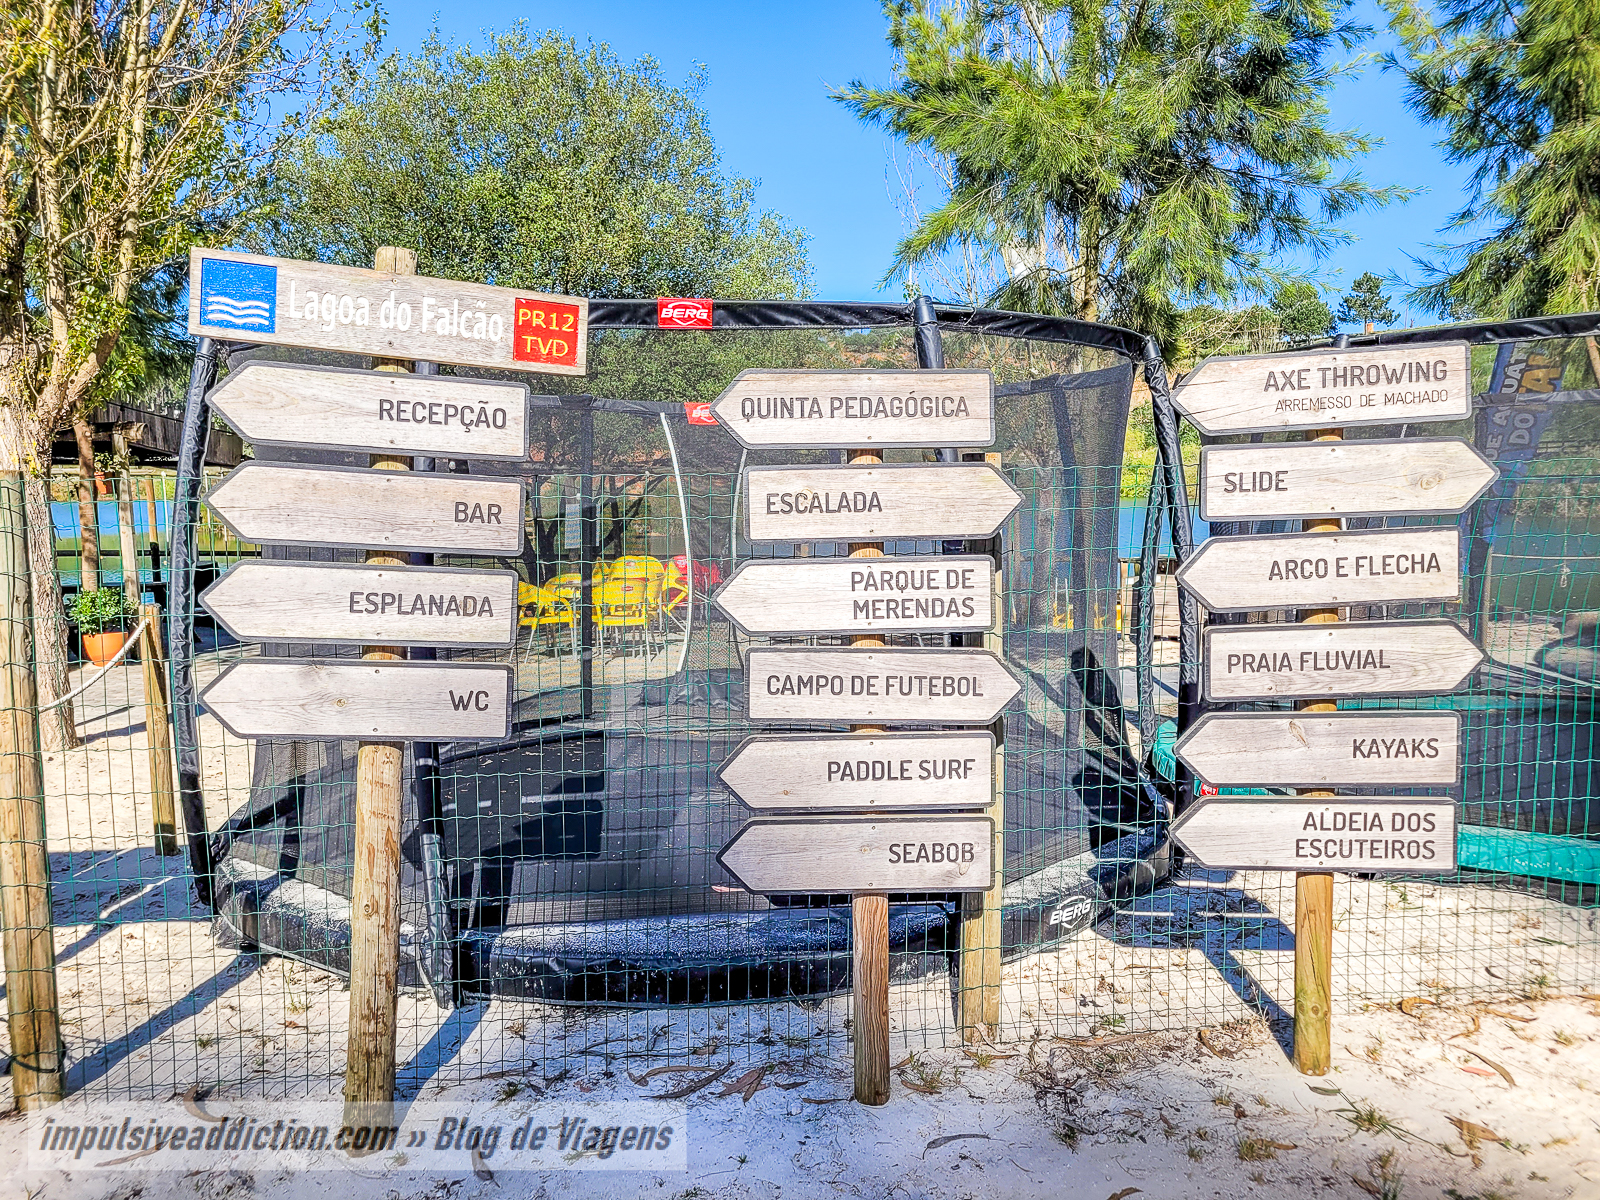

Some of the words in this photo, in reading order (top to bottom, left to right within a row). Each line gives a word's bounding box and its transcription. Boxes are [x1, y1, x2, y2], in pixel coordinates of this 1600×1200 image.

[289, 280, 371, 332] Lagoa
[380, 292, 412, 332] do
[422, 298, 504, 342] Falcão
[518, 308, 575, 332] PR12
[661, 308, 708, 319] BERG
[522, 336, 569, 357] TVD
[1264, 368, 1311, 392] AXE
[1317, 360, 1448, 388] THROWING
[741, 396, 823, 422] QUINTA
[830, 391, 970, 418] PEDAGÓGICA
[1275, 395, 1352, 413] ARREMESSO
[1360, 393, 1377, 407] DE
[1384, 389, 1449, 406] MACHADO
[379, 398, 507, 433] RECEPÇÃO
[1509, 413, 1535, 445] DO
[1224, 471, 1289, 493] SLIDE
[454, 501, 502, 524] BAR
[766, 491, 883, 515] ESCALADA
[1268, 557, 1329, 581] ARCO
[1336, 557, 1349, 578] E
[1355, 552, 1442, 576] FLECHA
[850, 569, 939, 593] PARQUE
[946, 568, 975, 589] DE
[350, 591, 494, 617] ESPLANADA
[853, 597, 975, 620] MERENDAS
[1228, 652, 1293, 673] PRAIA
[1299, 649, 1391, 672] FLUVIAL
[767, 675, 844, 696] CAMPO
[851, 675, 879, 696] DE
[885, 676, 984, 697] FUTEBOL
[449, 690, 490, 711] WC
[1352, 737, 1440, 759] KAYAKS
[827, 760, 913, 781] PADDLE
[918, 759, 976, 780] SURF
[1302, 811, 1384, 832] ALDEIA
[1391, 812, 1436, 832] DOS
[888, 842, 975, 864] SEABOB
[1295, 838, 1436, 860] ESCUTEIROS
[1050, 898, 1092, 925] BERG
